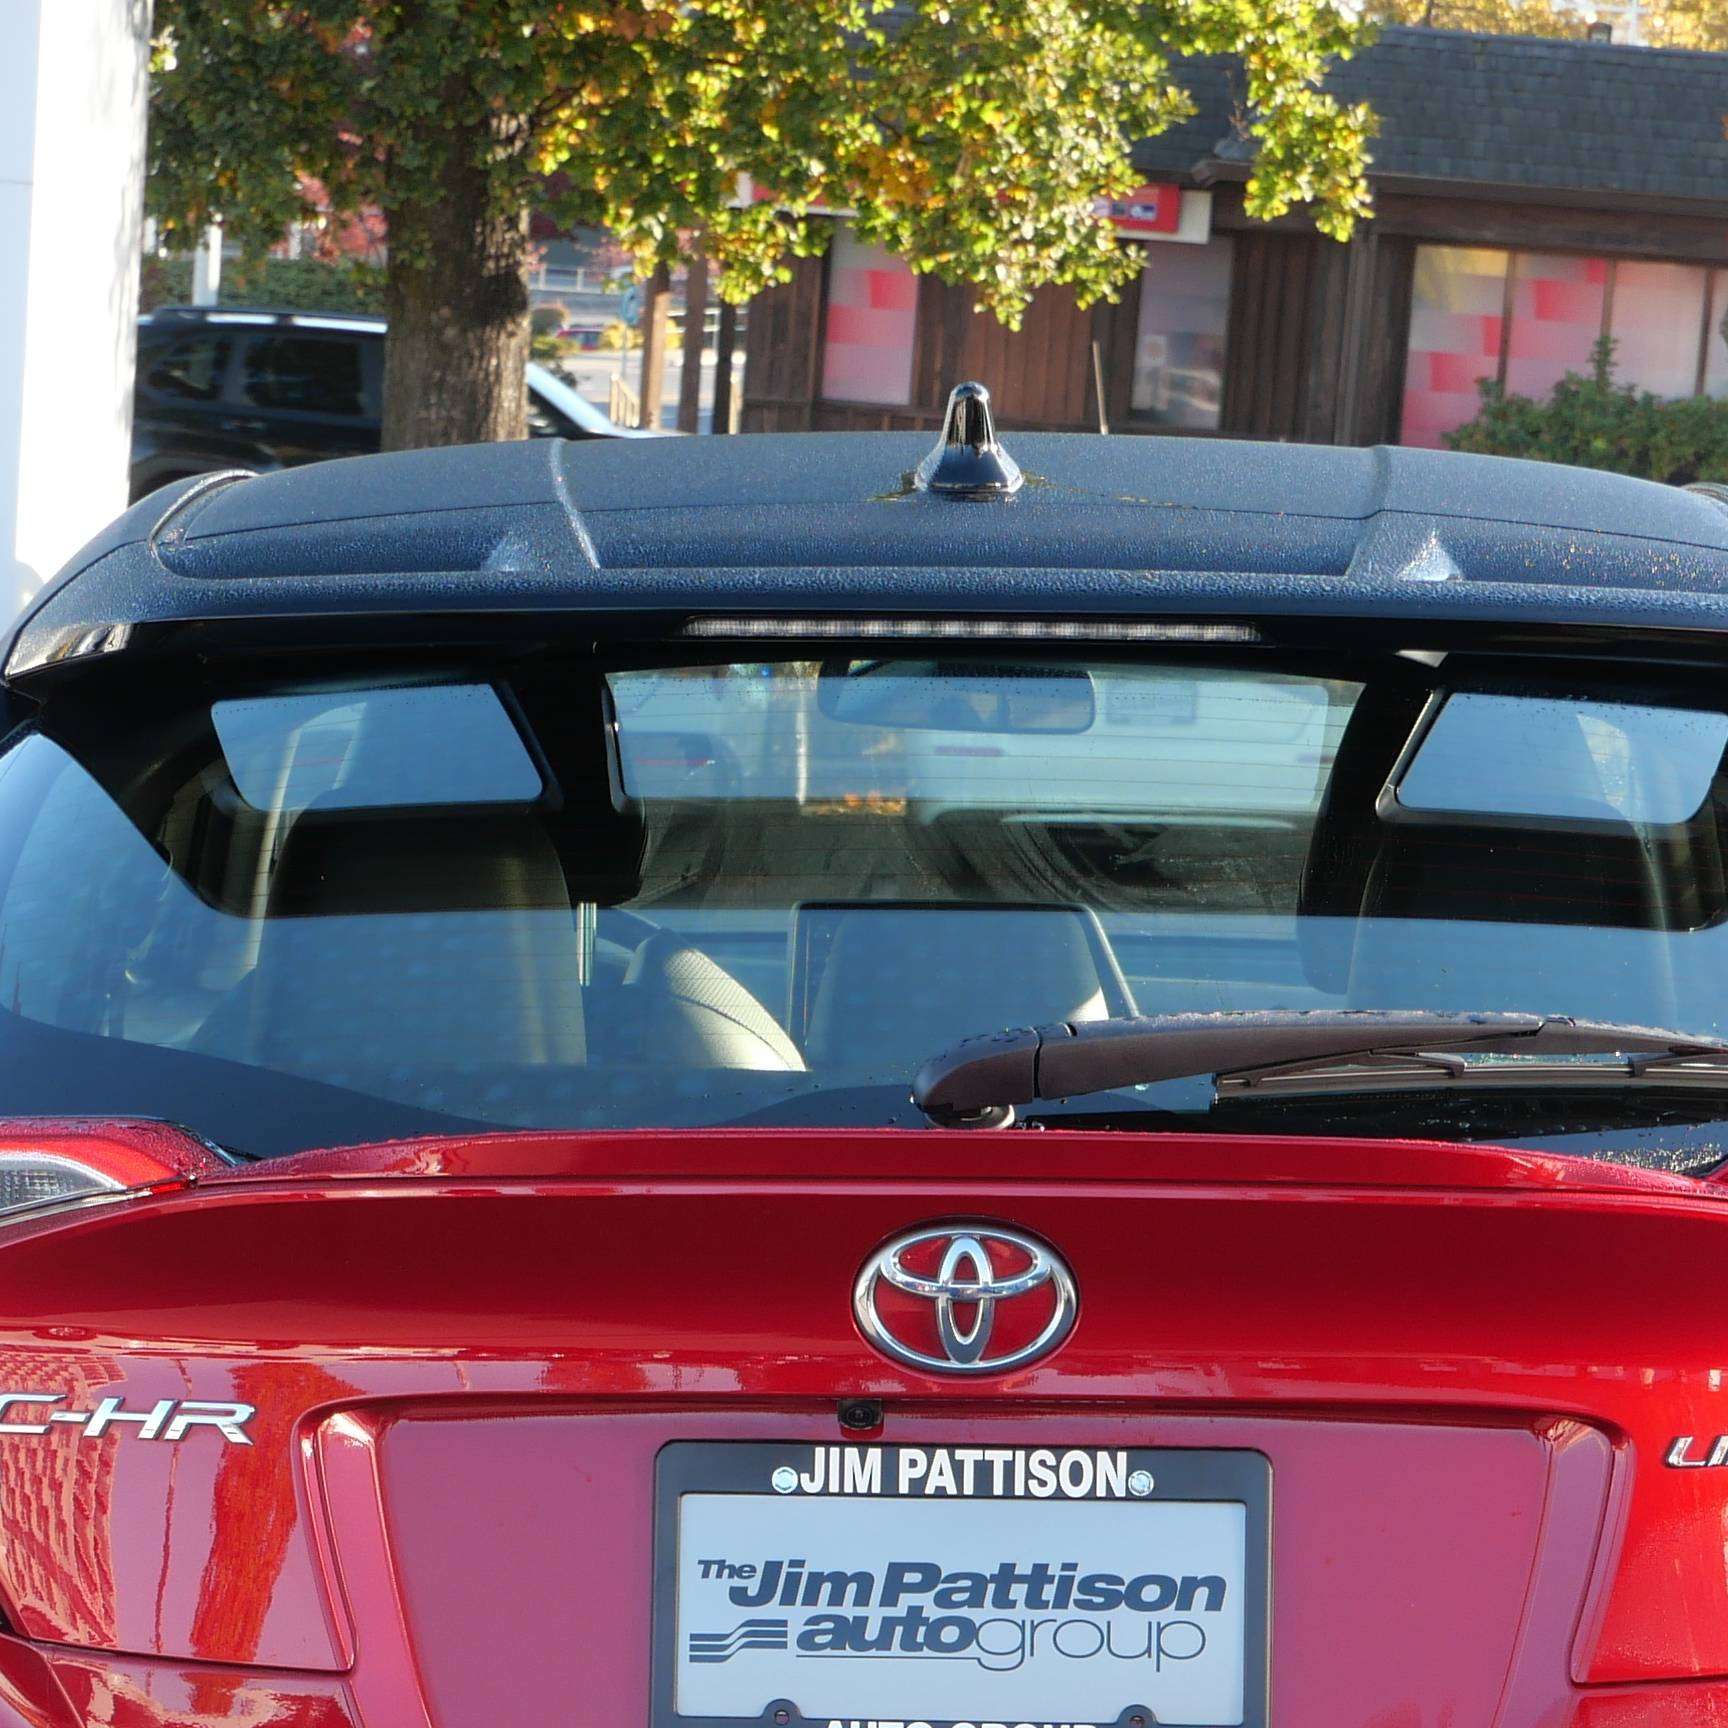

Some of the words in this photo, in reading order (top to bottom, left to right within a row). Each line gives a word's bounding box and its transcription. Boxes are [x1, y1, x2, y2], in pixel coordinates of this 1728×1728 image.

[799, 1446, 882, 1494] JIM
[897, 1448, 1128, 1498] PATTISON
[697, 1558, 757, 1580] The
